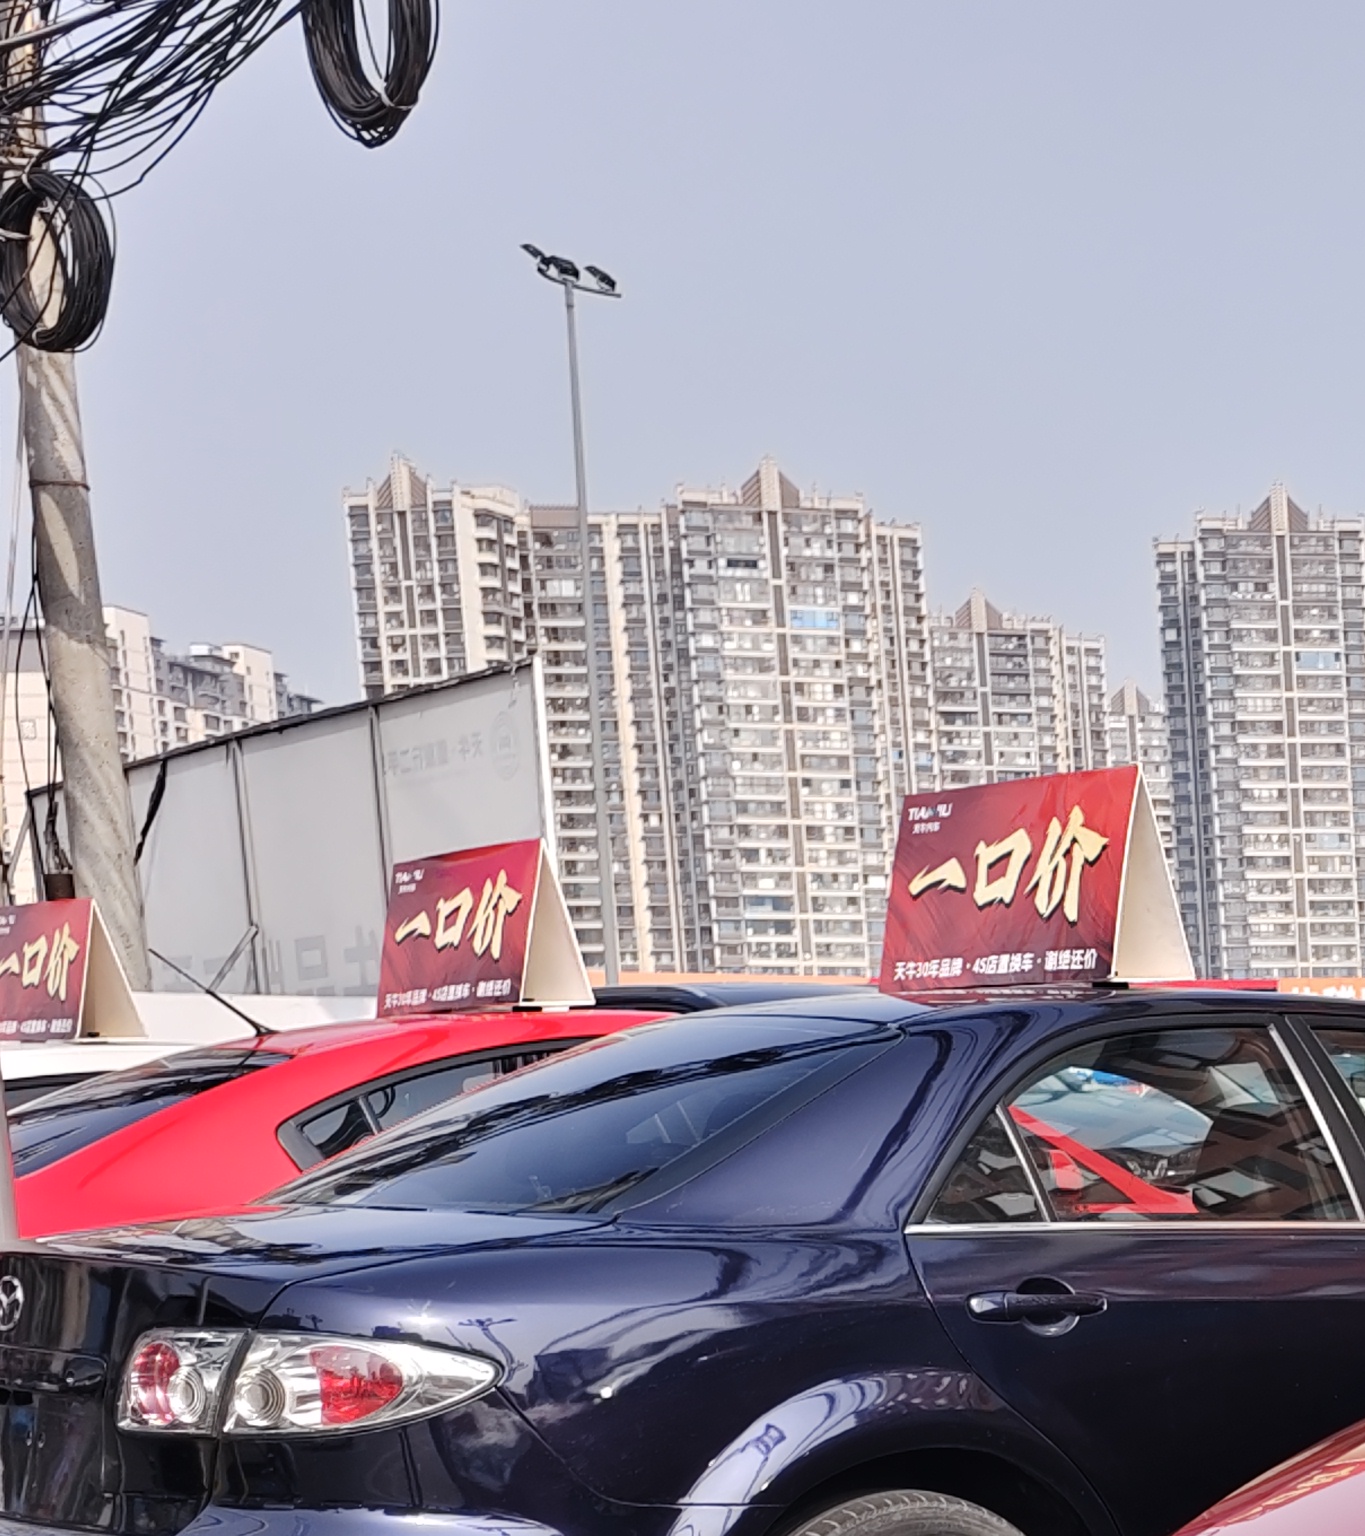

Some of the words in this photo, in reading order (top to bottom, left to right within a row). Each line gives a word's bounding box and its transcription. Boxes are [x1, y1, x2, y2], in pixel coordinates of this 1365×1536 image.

[393, 868, 523, 963] 一口价
[907, 804, 1110, 926] 一口价
